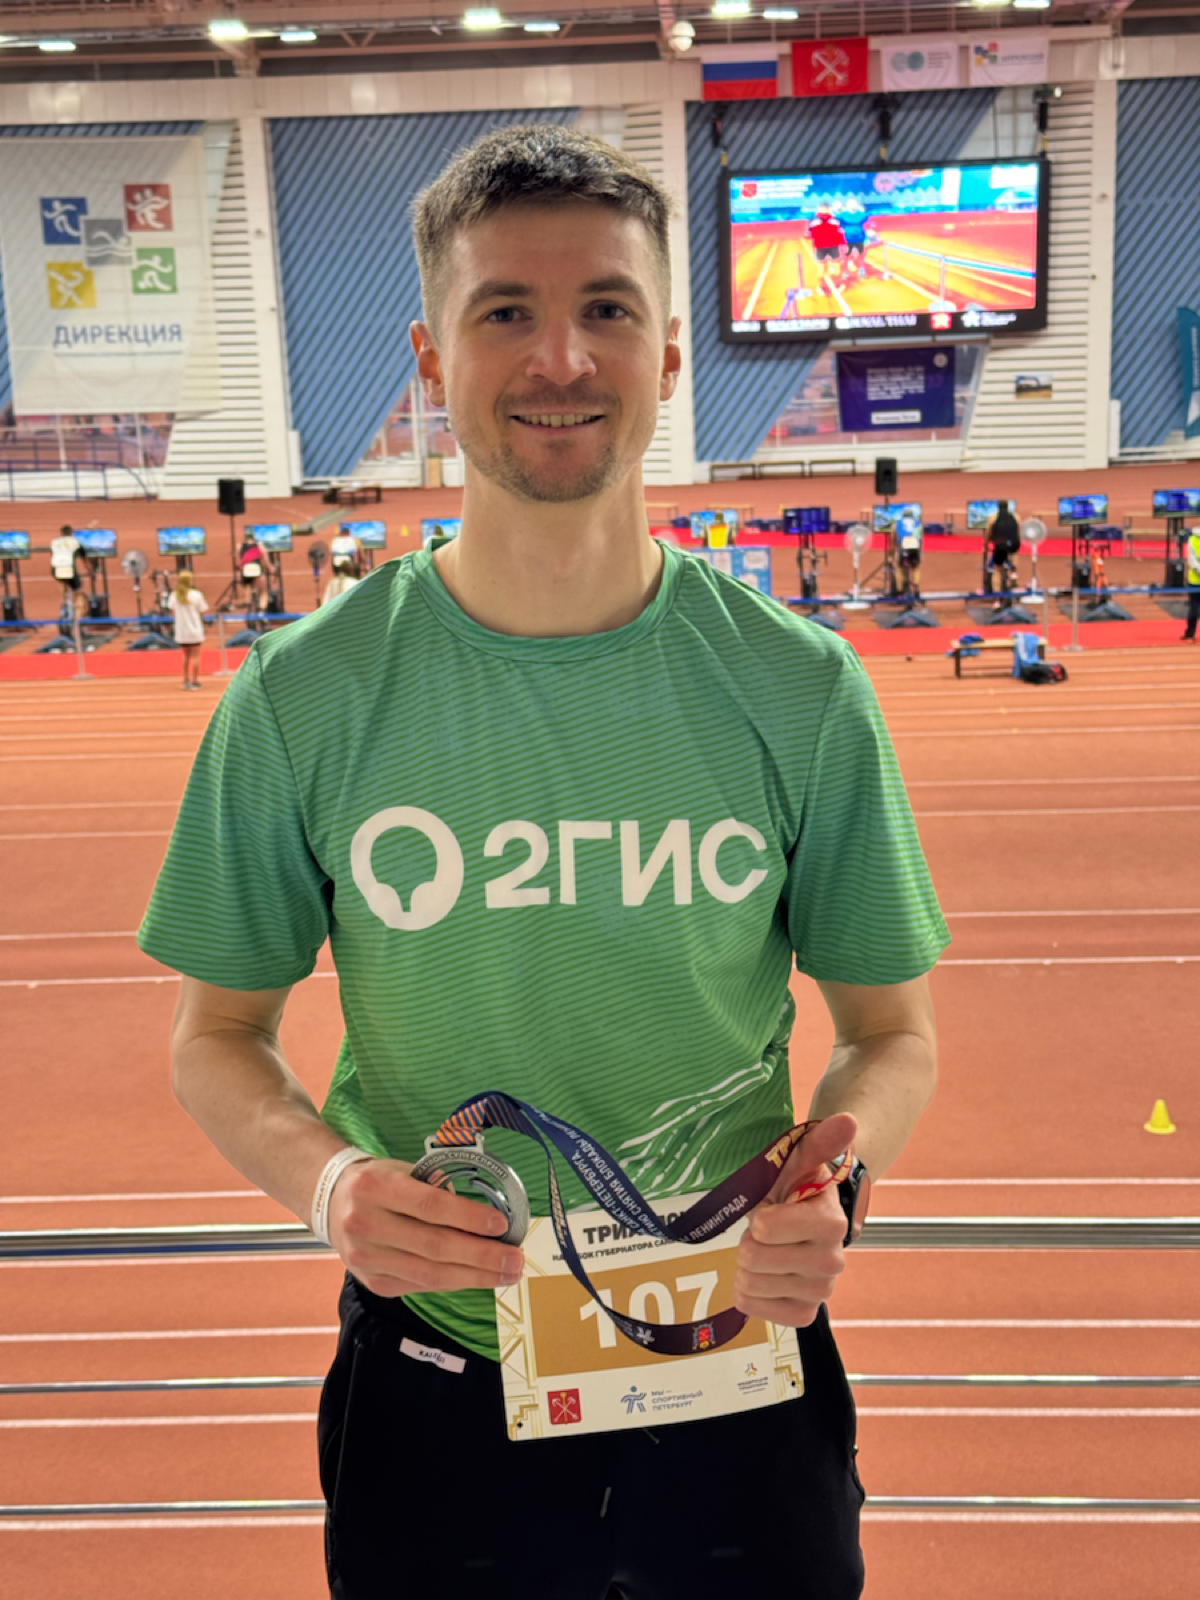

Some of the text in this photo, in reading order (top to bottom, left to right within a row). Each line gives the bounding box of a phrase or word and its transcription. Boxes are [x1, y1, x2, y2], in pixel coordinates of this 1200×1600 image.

[53, 323, 182, 348] ДИРЕКЦИЯ
[484, 817, 768, 908] 2ГИС
[576, 1138, 615, 1181] БЛОКАДЫ
[609, 1180, 641, 1216] СНЯТИЯ
[689, 1194, 749, 1240] ЛЕНИНГРАДА
[595, 1241, 653, 1258] ГУБЕРНАТОРА
[580, 1270, 719, 1348] 107
[652, 1400, 692, 1411] ПЕТЕРБУРГ
